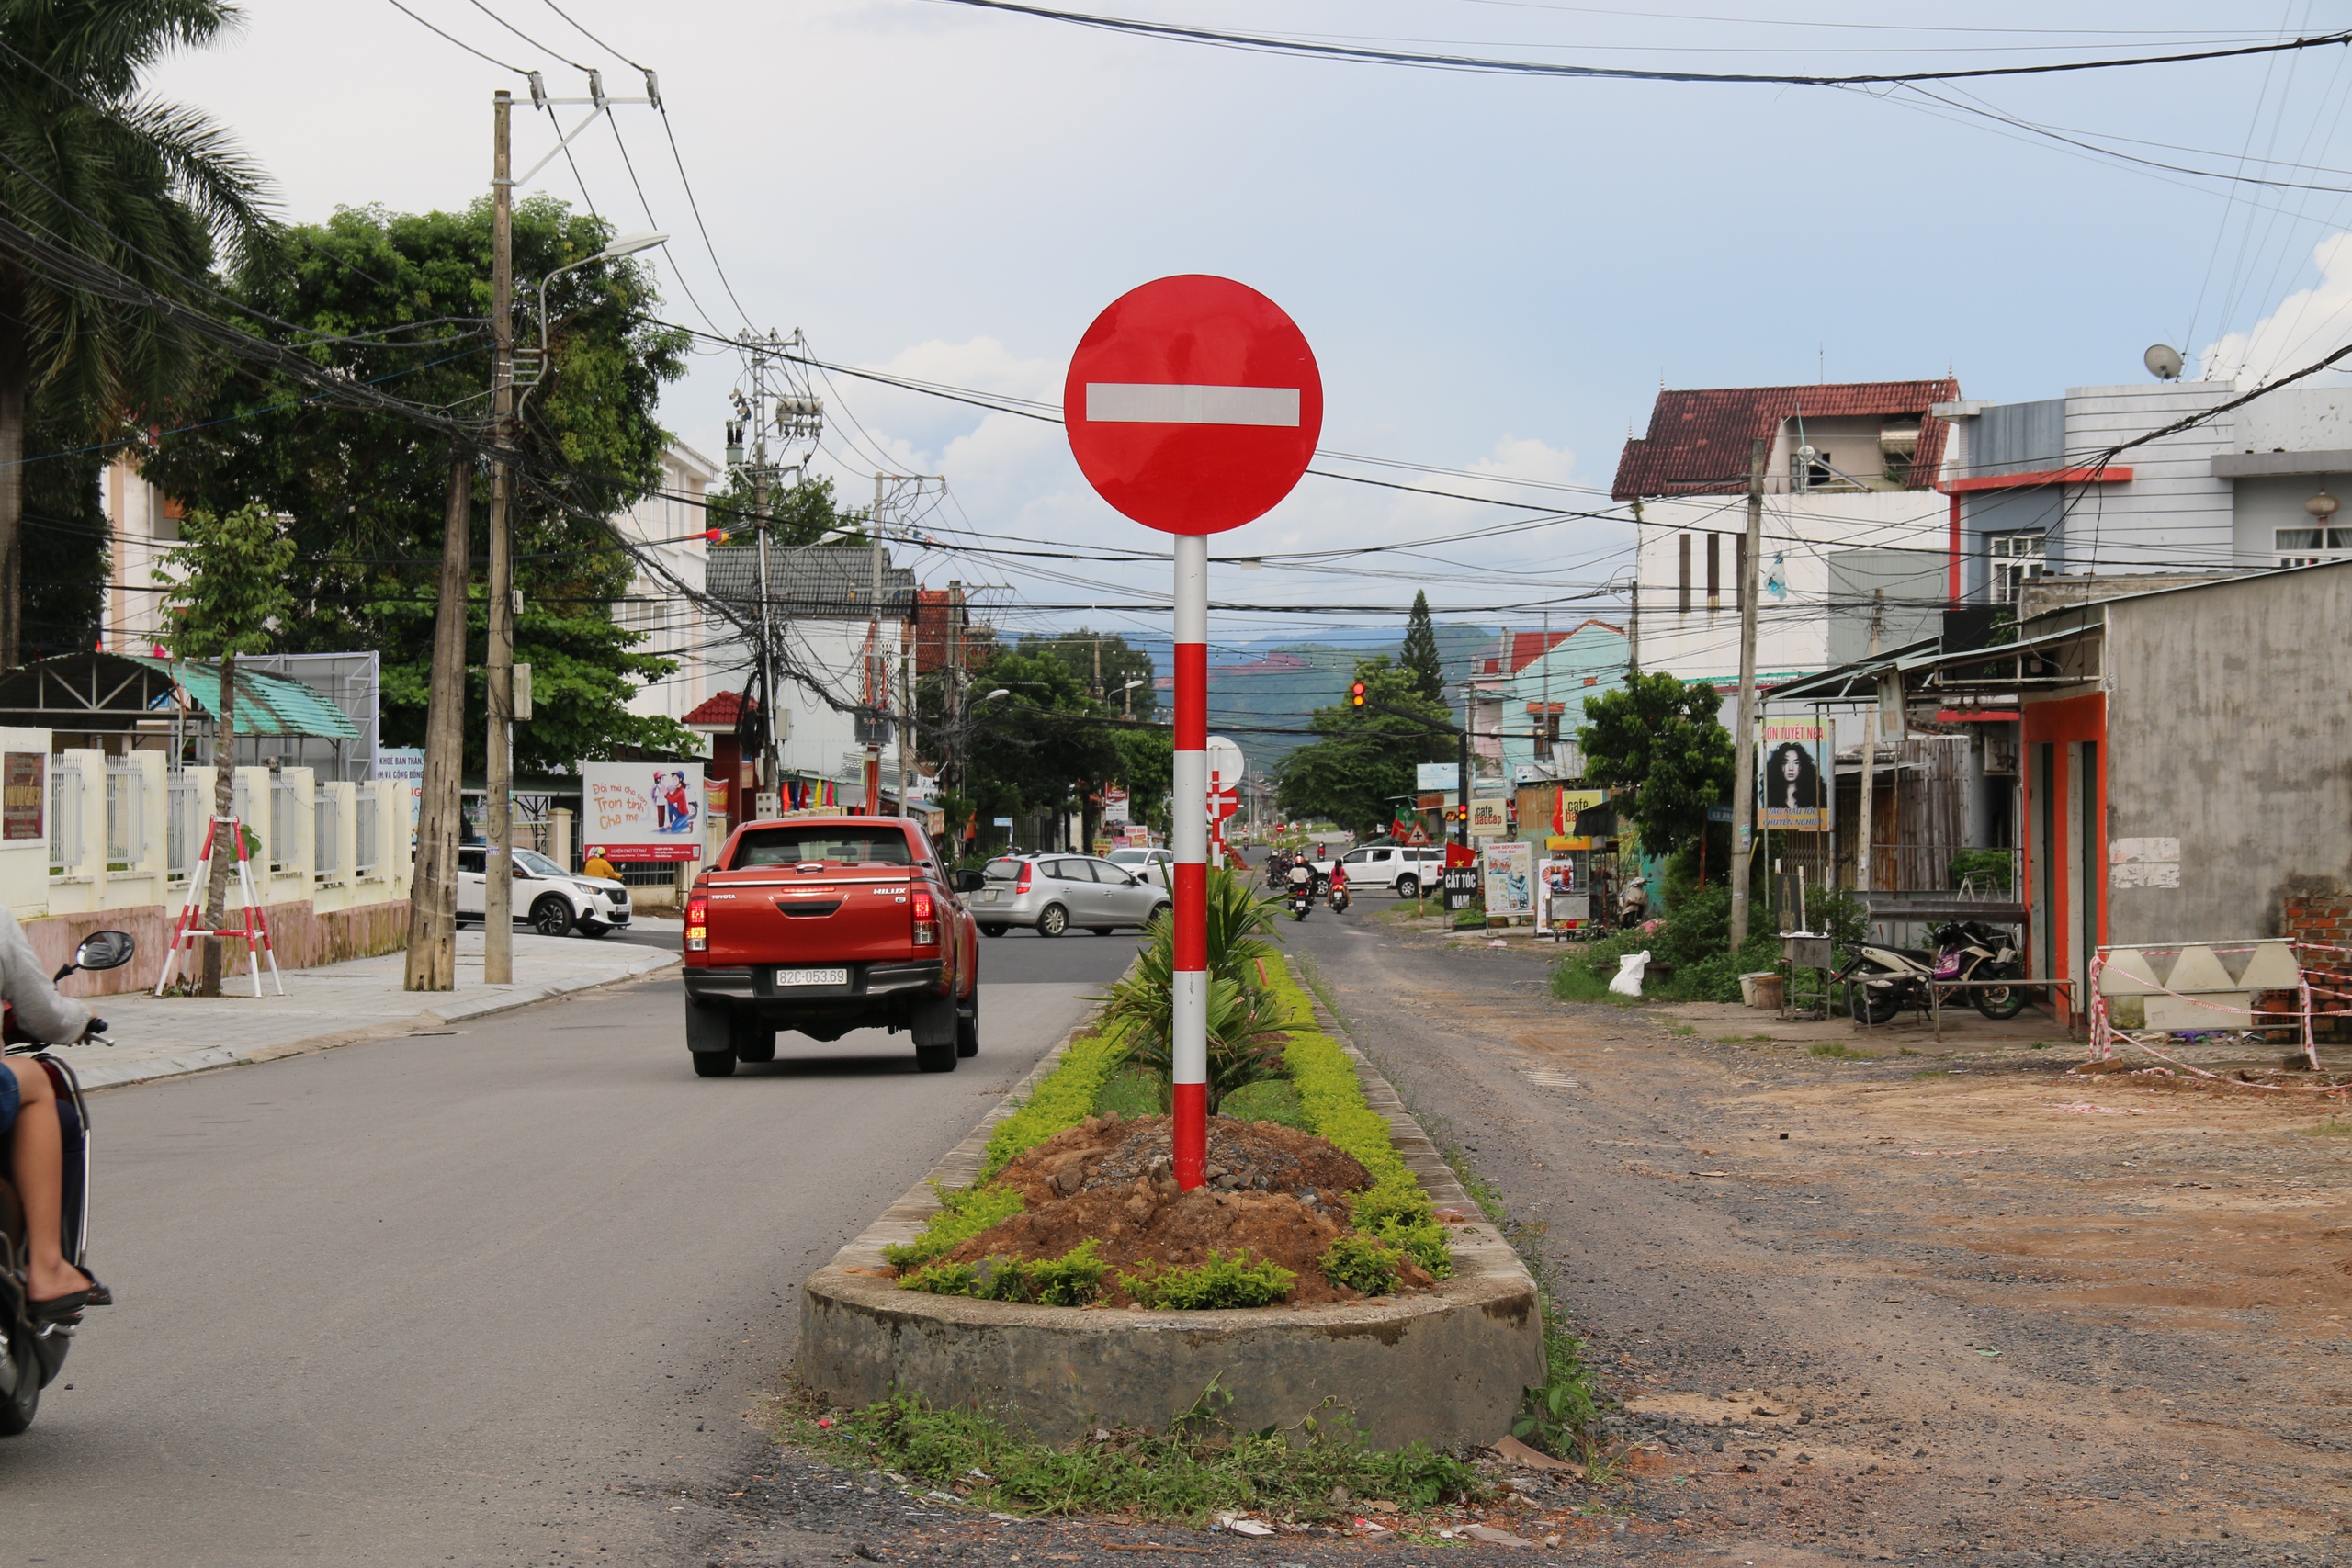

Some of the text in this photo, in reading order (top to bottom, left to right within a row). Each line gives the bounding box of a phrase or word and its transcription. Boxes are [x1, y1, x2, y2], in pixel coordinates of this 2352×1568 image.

[1780, 722, 1804, 740] TUYẾT
[624, 786, 636, 795] cho
[638, 794, 648, 807] con
[594, 797, 623, 813] Trọn
[599, 813, 622, 829] Cha
[1445, 869, 1476, 889] CẮT TÓC
[1452, 895, 1470, 908] NAM
[779, 970, 844, 984] 82C-053.69
